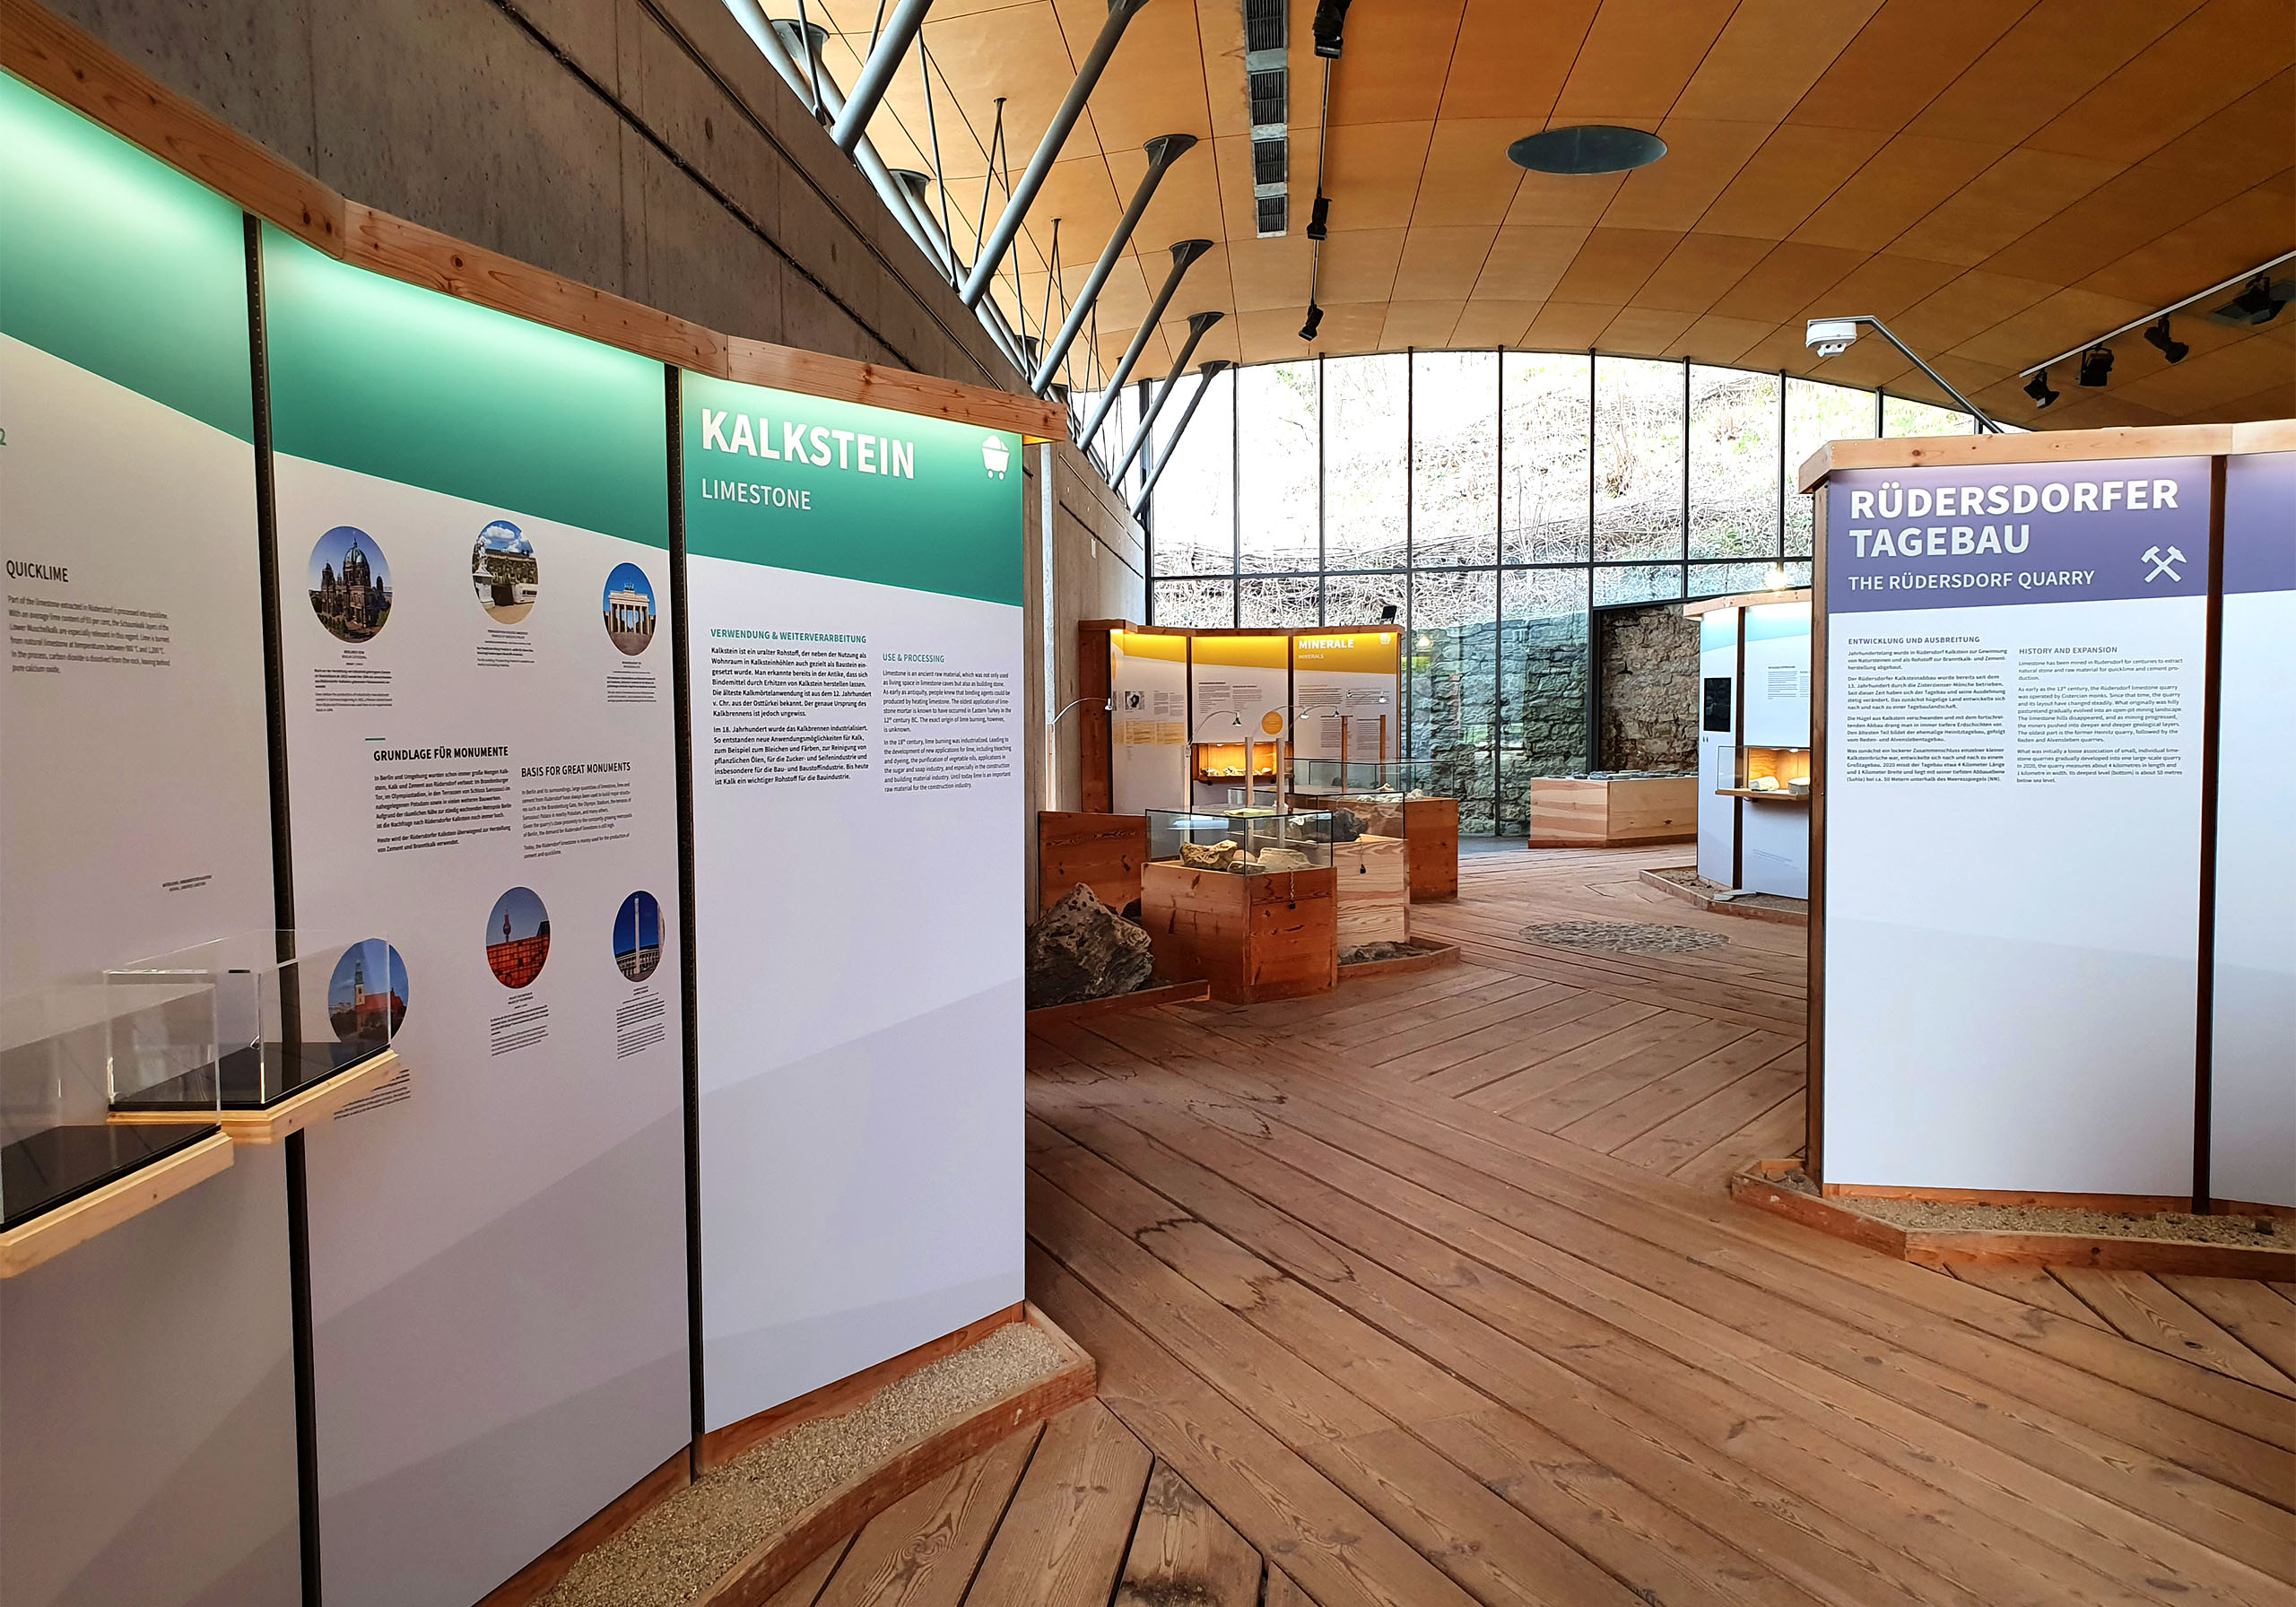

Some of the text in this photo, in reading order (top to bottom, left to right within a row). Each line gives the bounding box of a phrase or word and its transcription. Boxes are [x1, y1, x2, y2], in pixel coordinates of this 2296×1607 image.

[702, 408, 914, 479] KALKSTEIN
[702, 478, 811, 510] LIMESTONE
[1851, 479, 2178, 519] RÜDERSDORFER
[1849, 524, 2029, 557] TAGEBAU
[7, 560, 68, 582] QUICKLIME
[1848, 571, 2095, 590] THE RÜDERSDORF QUARRY
[711, 629, 770, 639] VERWENDUNG
[780, 632, 866, 643] WEITERVERARBEITUNG
[1299, 639, 1354, 649] MINERALE
[904, 654, 944, 662] PROCESSING
[374, 746, 508, 761] GRUNDLAGE FÜR MONUMENTE
[522, 762, 630, 777] BASIS FOR GREAT MONUMENTS
